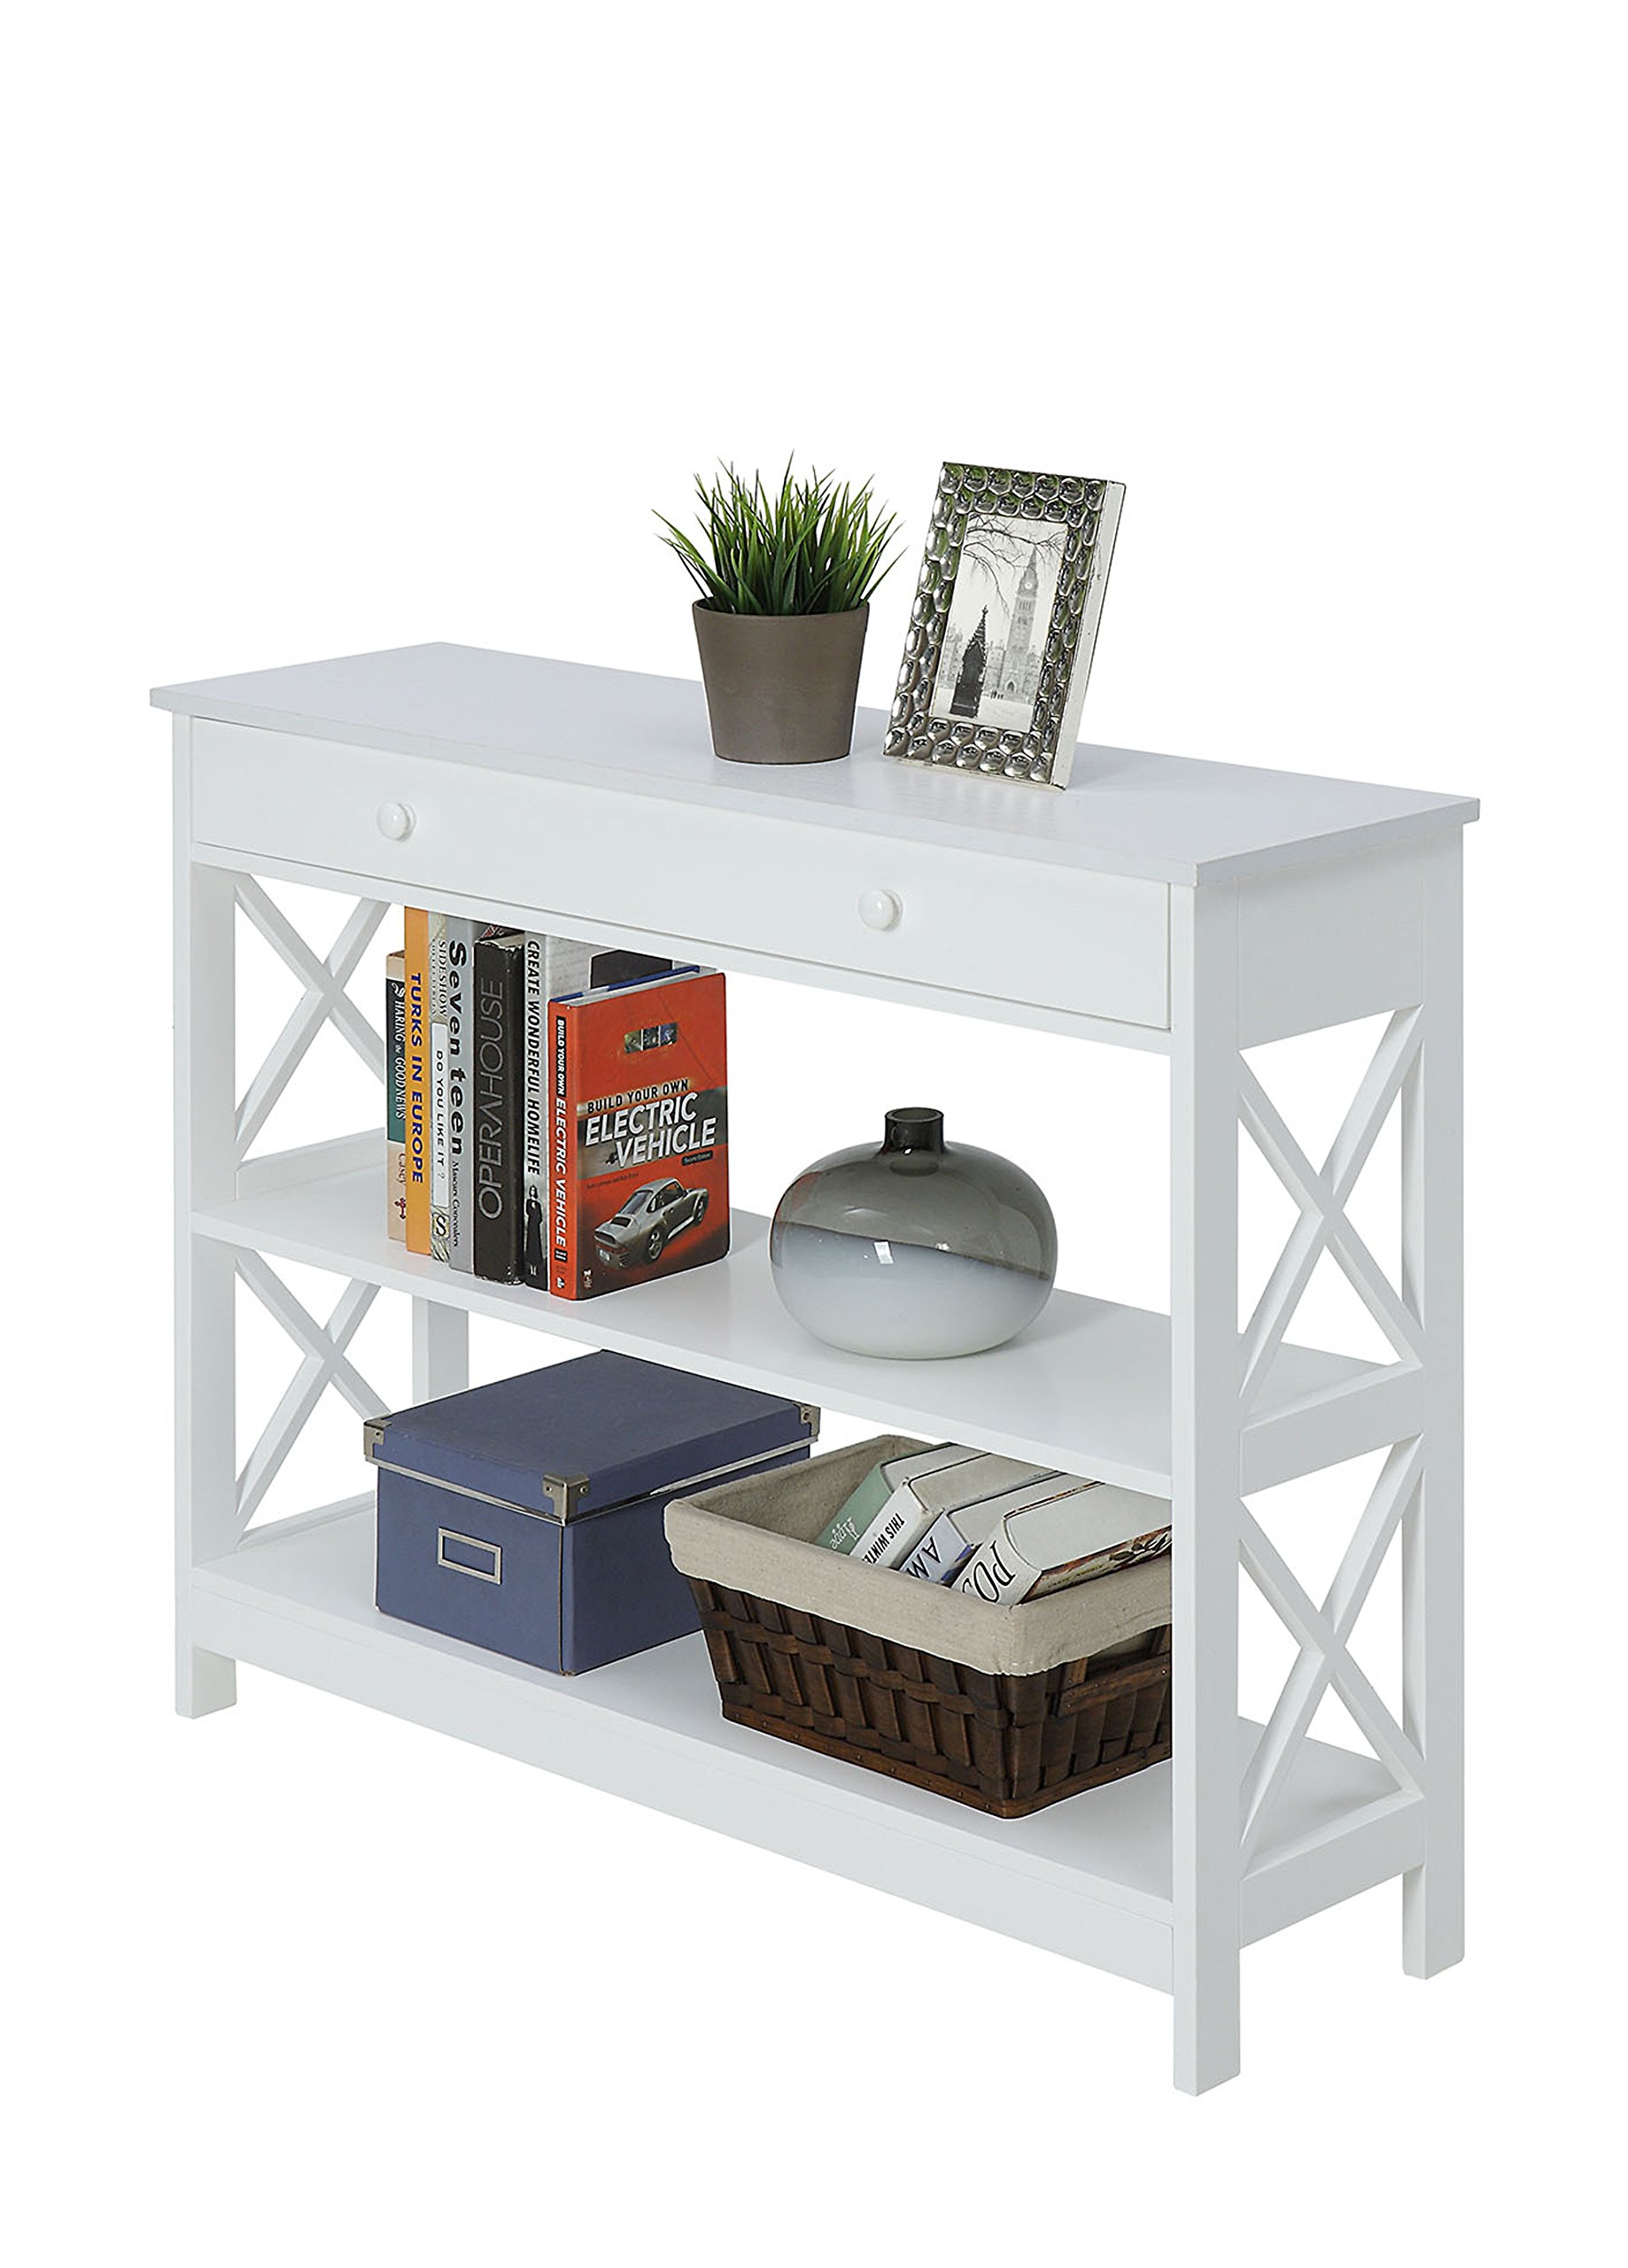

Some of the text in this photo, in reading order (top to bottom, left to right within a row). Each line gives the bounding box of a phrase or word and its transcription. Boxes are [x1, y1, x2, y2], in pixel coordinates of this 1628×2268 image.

[438, 940, 447, 1017] SIDESHOW
[410, 972, 423, 1184] TURKS IN EUROPE
[436, 1050, 443, 1072] DO
[527, 940, 539, 1176] CREATE WONDERFUL HOMELIFE
[450, 1068, 466, 1155] teen
[478, 978, 503, 1220] OPERAHOUSE
[585, 1092, 698, 1146] ELECTRIC
[587, 1078, 689, 1114] BUILD YOUR OWN
[438, 1153, 444, 1167] IT
[556, 1097, 566, 1175] ELECTRIC
[616, 1117, 717, 1168] VEHICLE
[556, 1178, 566, 1247] VEHICLE
[885, 1512, 905, 1539] THIS
